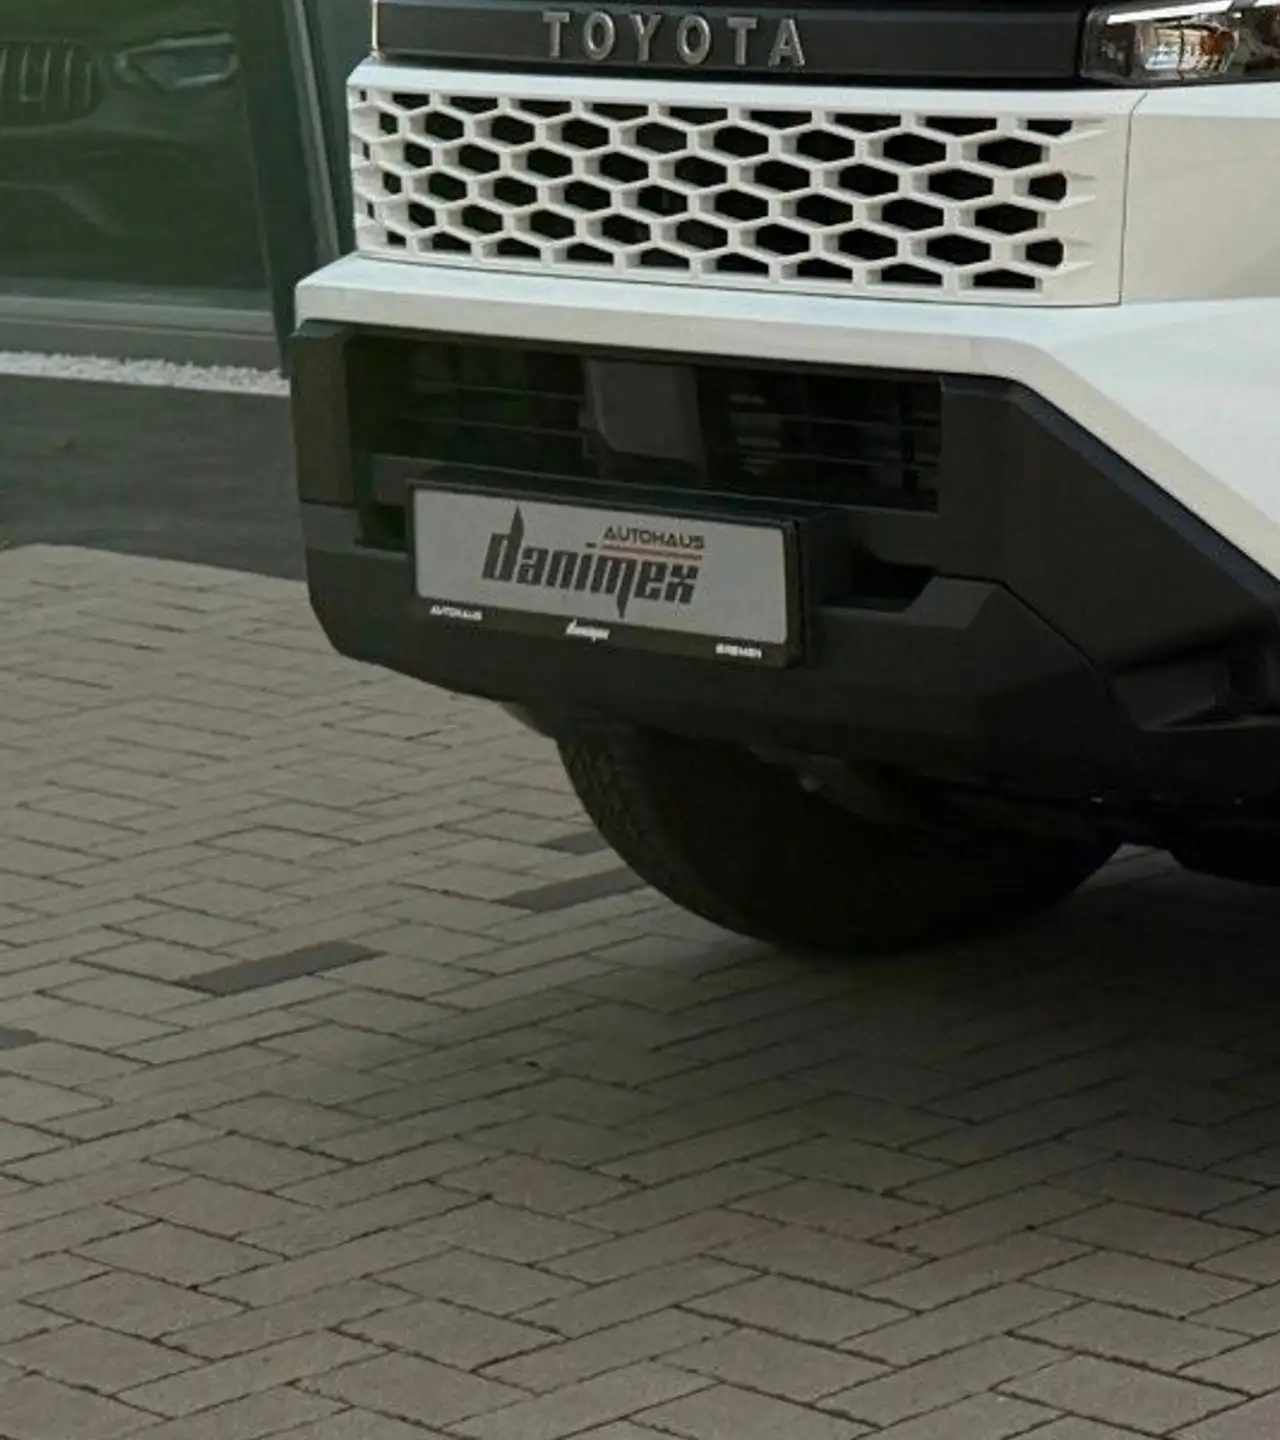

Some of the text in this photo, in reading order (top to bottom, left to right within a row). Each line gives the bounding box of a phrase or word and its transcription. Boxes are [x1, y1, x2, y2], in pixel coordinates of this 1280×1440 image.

[542, 11, 806, 67] TOYOTA
[481, 504, 699, 619] danimex
[603, 525, 705, 550] AUTOHAUS
